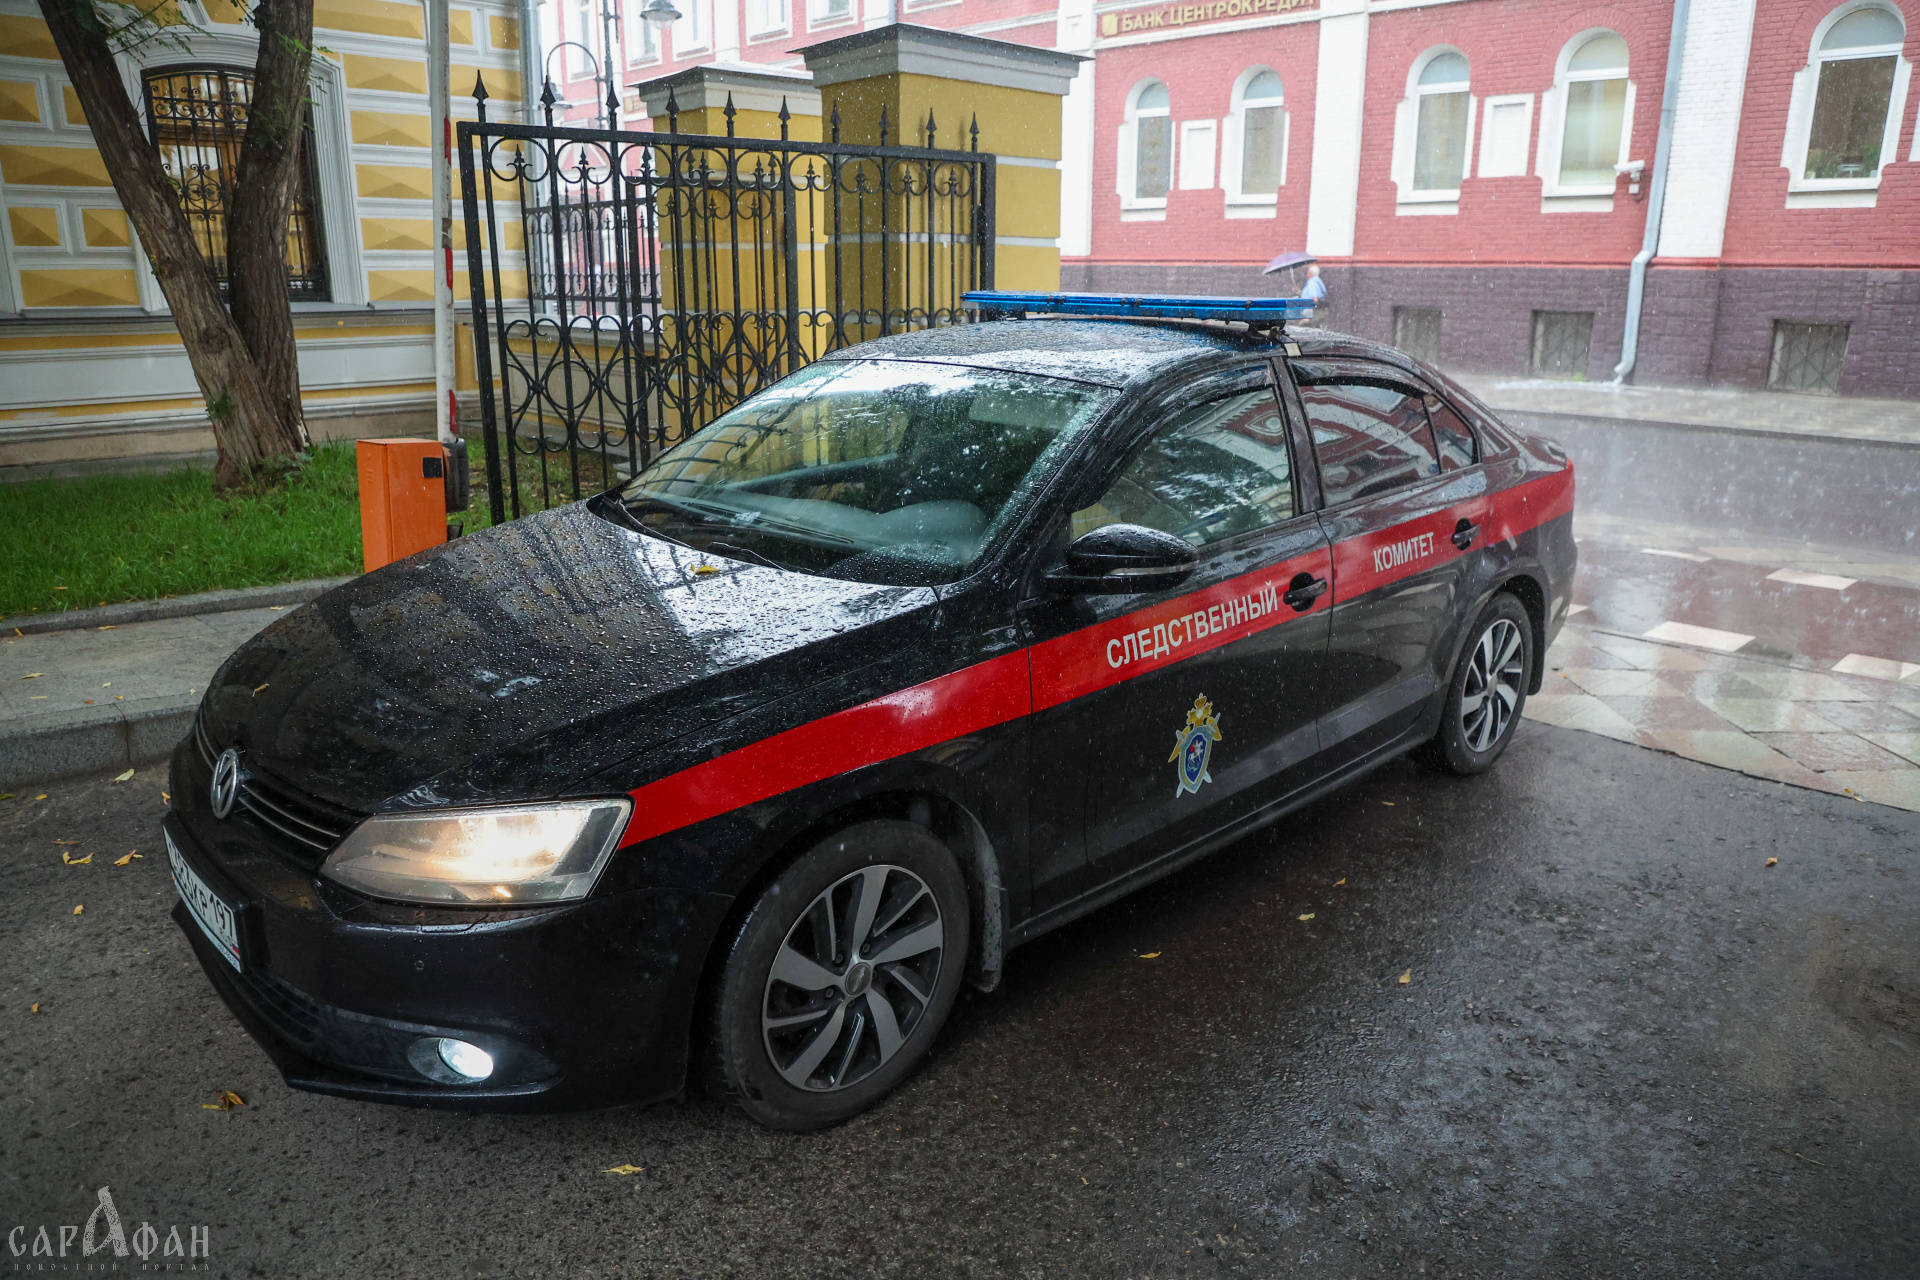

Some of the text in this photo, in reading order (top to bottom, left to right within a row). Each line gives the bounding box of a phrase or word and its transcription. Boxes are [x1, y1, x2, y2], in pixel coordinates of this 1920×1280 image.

[1121, 11, 1166, 32] БАНК
[1106, 532, 1434, 668] СЛЕДСТВЕННЫЙ КОМИТЕТ
[209, 892, 233, 938] 197
